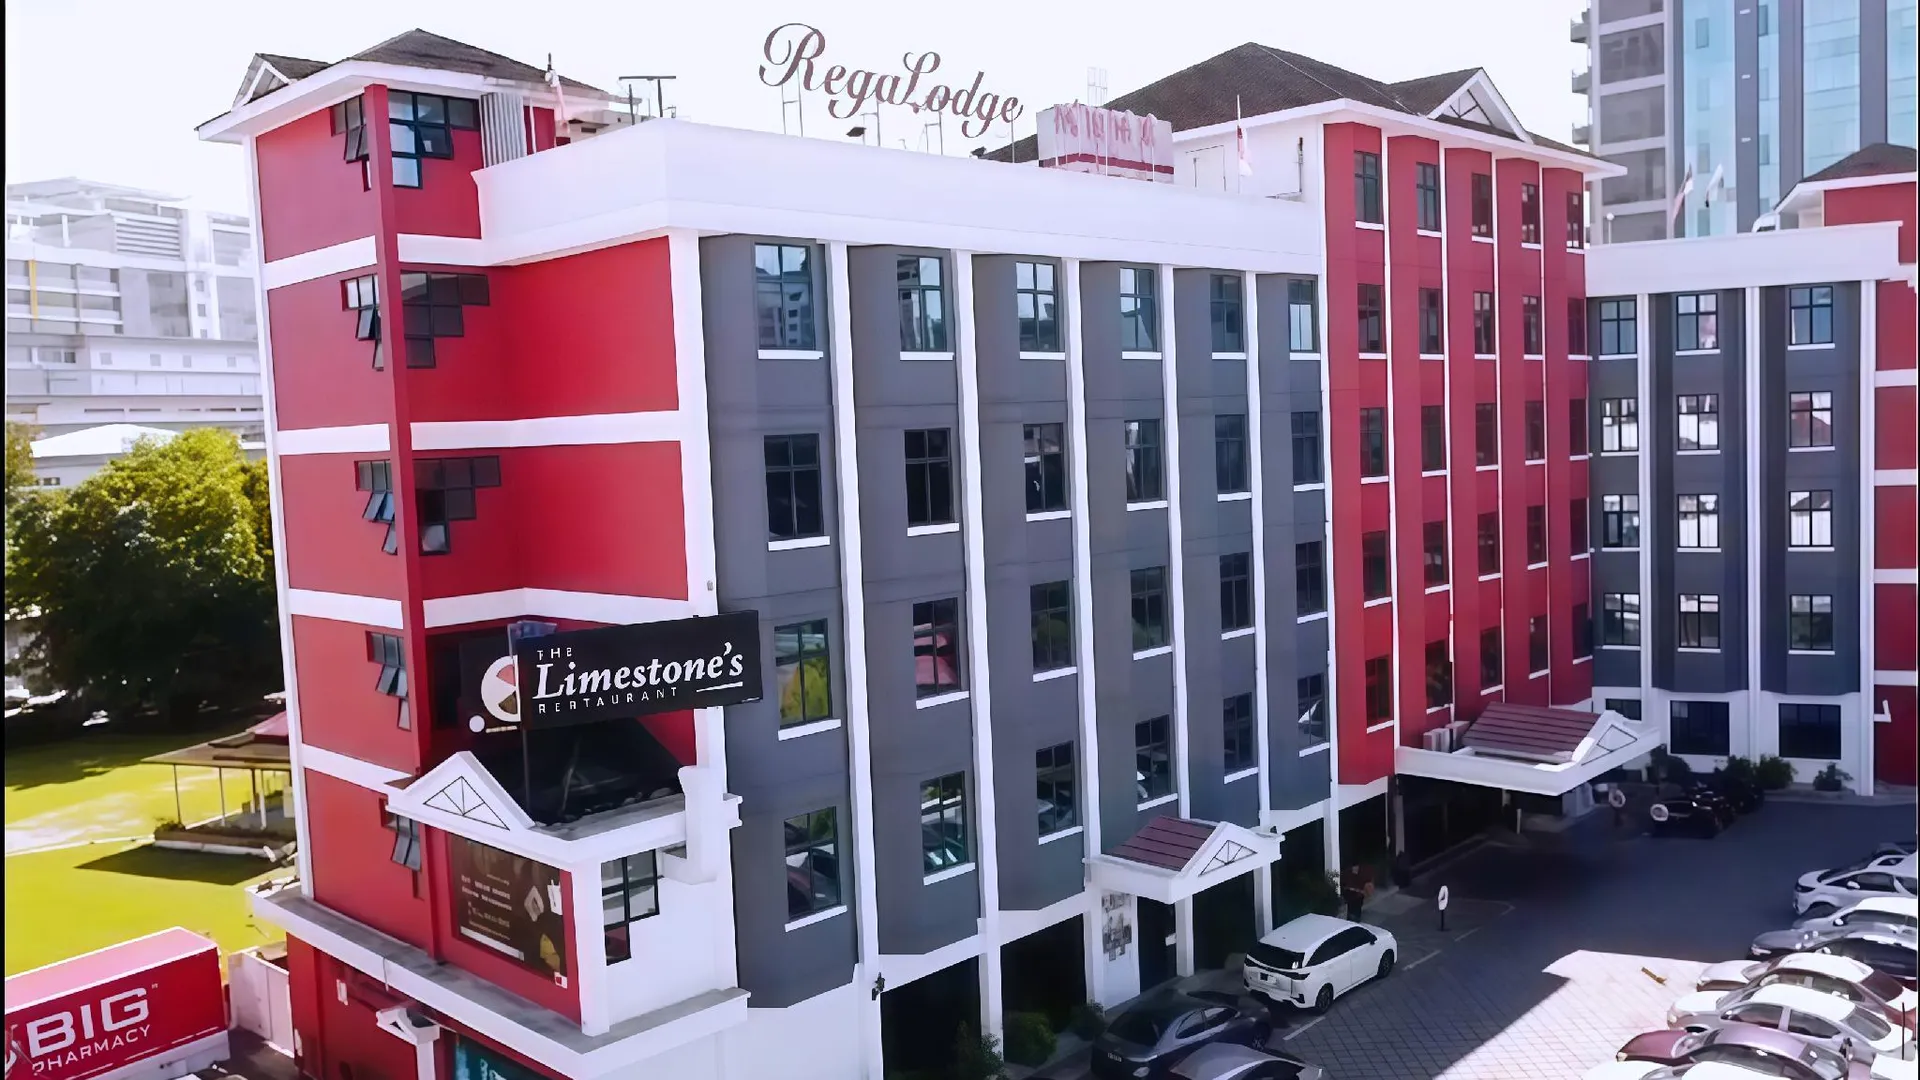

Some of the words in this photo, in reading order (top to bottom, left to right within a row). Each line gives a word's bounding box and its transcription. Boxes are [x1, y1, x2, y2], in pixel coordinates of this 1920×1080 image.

[759, 22, 1024, 139] RegaLodge
[532, 641, 744, 700] Limestone's
[26, 987, 150, 1059] BIG
[32, 1024, 151, 1076] PHARMACY
